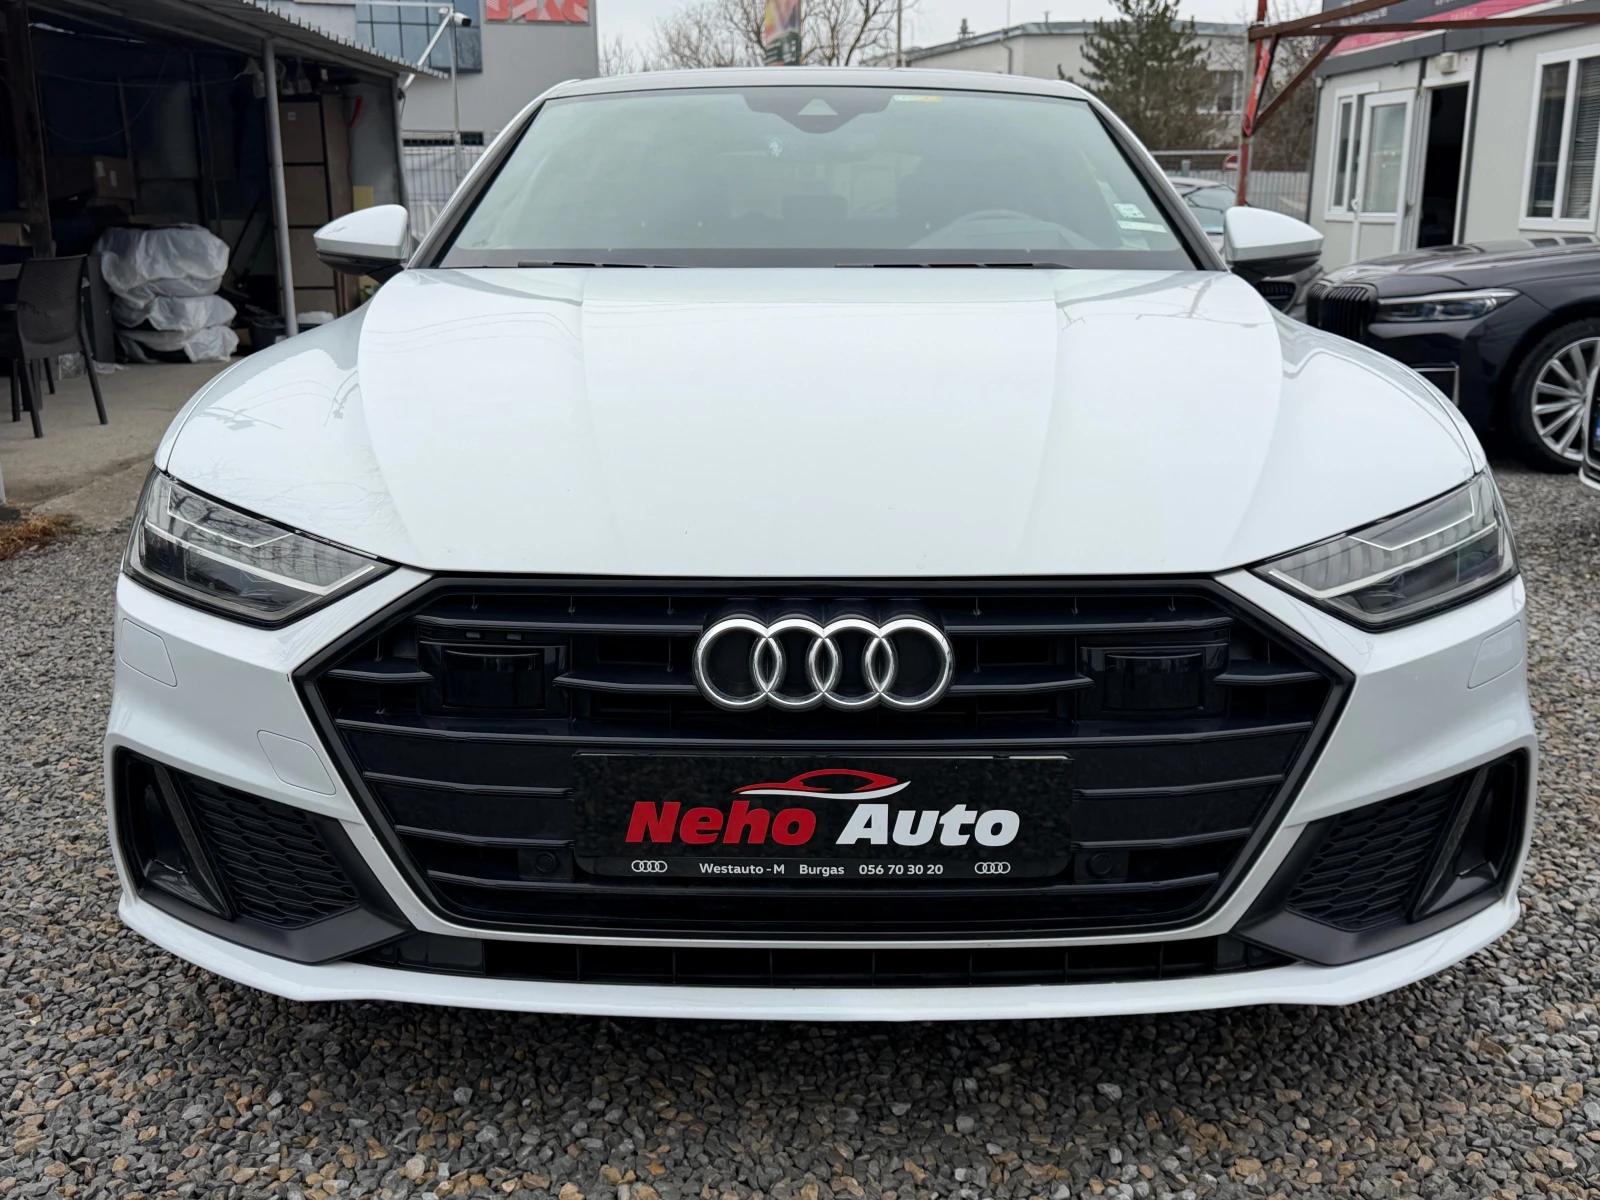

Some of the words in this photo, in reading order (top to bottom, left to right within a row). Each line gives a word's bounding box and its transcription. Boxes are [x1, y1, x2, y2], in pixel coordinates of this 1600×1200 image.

[625, 800, 817, 846] Neho
[835, 803, 1020, 847] Auto
[799, 864, 845, 877] Burgas
[858, 864, 885, 875] 056
[887, 864, 904, 875] 70
[906, 864, 924, 875] 30
[926, 864, 944, 875] 20
